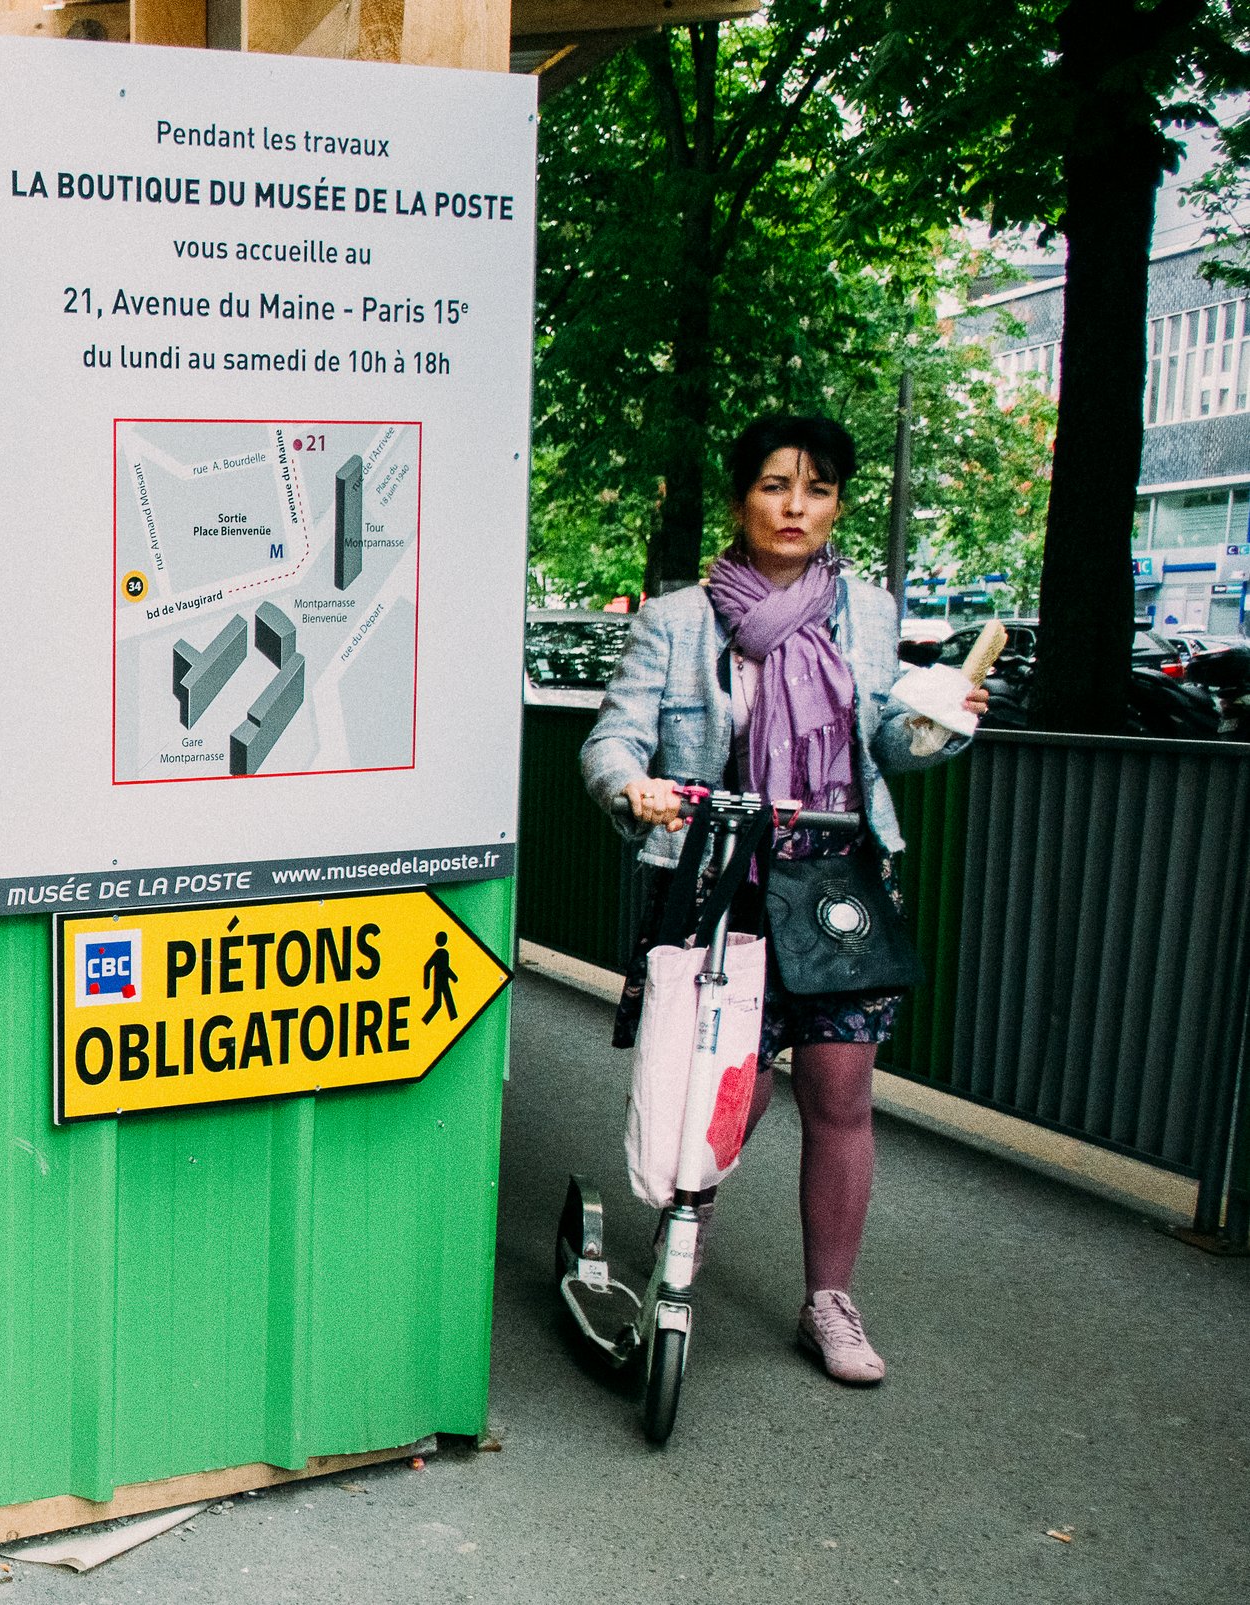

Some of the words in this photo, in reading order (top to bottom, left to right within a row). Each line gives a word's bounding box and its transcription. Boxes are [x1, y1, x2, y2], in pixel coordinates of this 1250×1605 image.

[158, 121, 254, 149] Pendant
[264, 127, 296, 151] les
[304, 131, 389, 157] travaux
[12, 170, 48, 198] LA
[58, 173, 200, 204] BOUTIQUE
[210, 180, 245, 206] DU
[255, 177, 346, 211] MUSÉE
[355, 188, 387, 213] DE
[396, 190, 427, 216] LA
[435, 192, 513, 220] POSTE
[174, 241, 228, 259] vous
[236, 240, 337, 263] accueille
[345, 248, 370, 265] au
[64, 287, 102, 318] 21,
[112, 289, 210, 317] Avenue
[220, 292, 249, 318] du
[260, 293, 334, 320] Maine
[363, 297, 424, 323] Paris
[83, 344, 111, 367] du
[121, 345, 179, 369] lundi
[188, 353, 215, 369] au
[224, 349, 306, 371] samedi
[315, 350, 340, 372] de
[349, 350, 386, 373] 10h
[394, 350, 404, 373] à
[414, 352, 449, 374] 18h
[276, 429, 287, 464] Maine
[306, 435, 325, 451] 21
[193, 464, 208, 475] rue
[213, 461, 222, 471] A.
[223, 453, 266, 469] Bourdelle
[282, 466, 291, 481] du
[353, 475, 364, 492] rue
[362, 462, 373, 475] de
[134, 463, 149, 506] Moisant
[376, 475, 390, 494] Place
[389, 464, 398, 475] du
[379, 497, 389, 507] 18
[387, 483, 398, 501] juin
[396, 464, 410, 483] 1940
[218, 513, 247, 523] Sortie
[285, 484, 298, 524] avenue
[143, 508, 159, 550] Armand
[193, 526, 218, 536] Place
[220, 526, 271, 536] Bienvenüe
[365, 523, 384, 533] Tour
[270, 544, 283, 558] M
[345, 538, 404, 549] Montparnasse
[154, 553, 164, 570] rue
[129, 581, 141, 592] 34
[147, 608, 160, 619] bd
[162, 605, 174, 615] de
[175, 590, 223, 611] Vaugirard
[294, 599, 356, 609] Montparnasse
[341, 645, 353, 661] rue
[353, 633, 363, 647] du
[182, 738, 203, 747] Gare
[160, 752, 224, 764] Montparnasse
[8, 876, 92, 906] MUSÉE
[99, 879, 132, 899] DE
[138, 876, 169, 897] LA
[175, 870, 253, 895] POSTE
[271, 851, 500, 884] www.museedelaposte.fr
[87, 955, 131, 979] CBC
[167, 916, 380, 998] PIÉTONS
[75, 996, 411, 1086] OBLIGATOIRE
